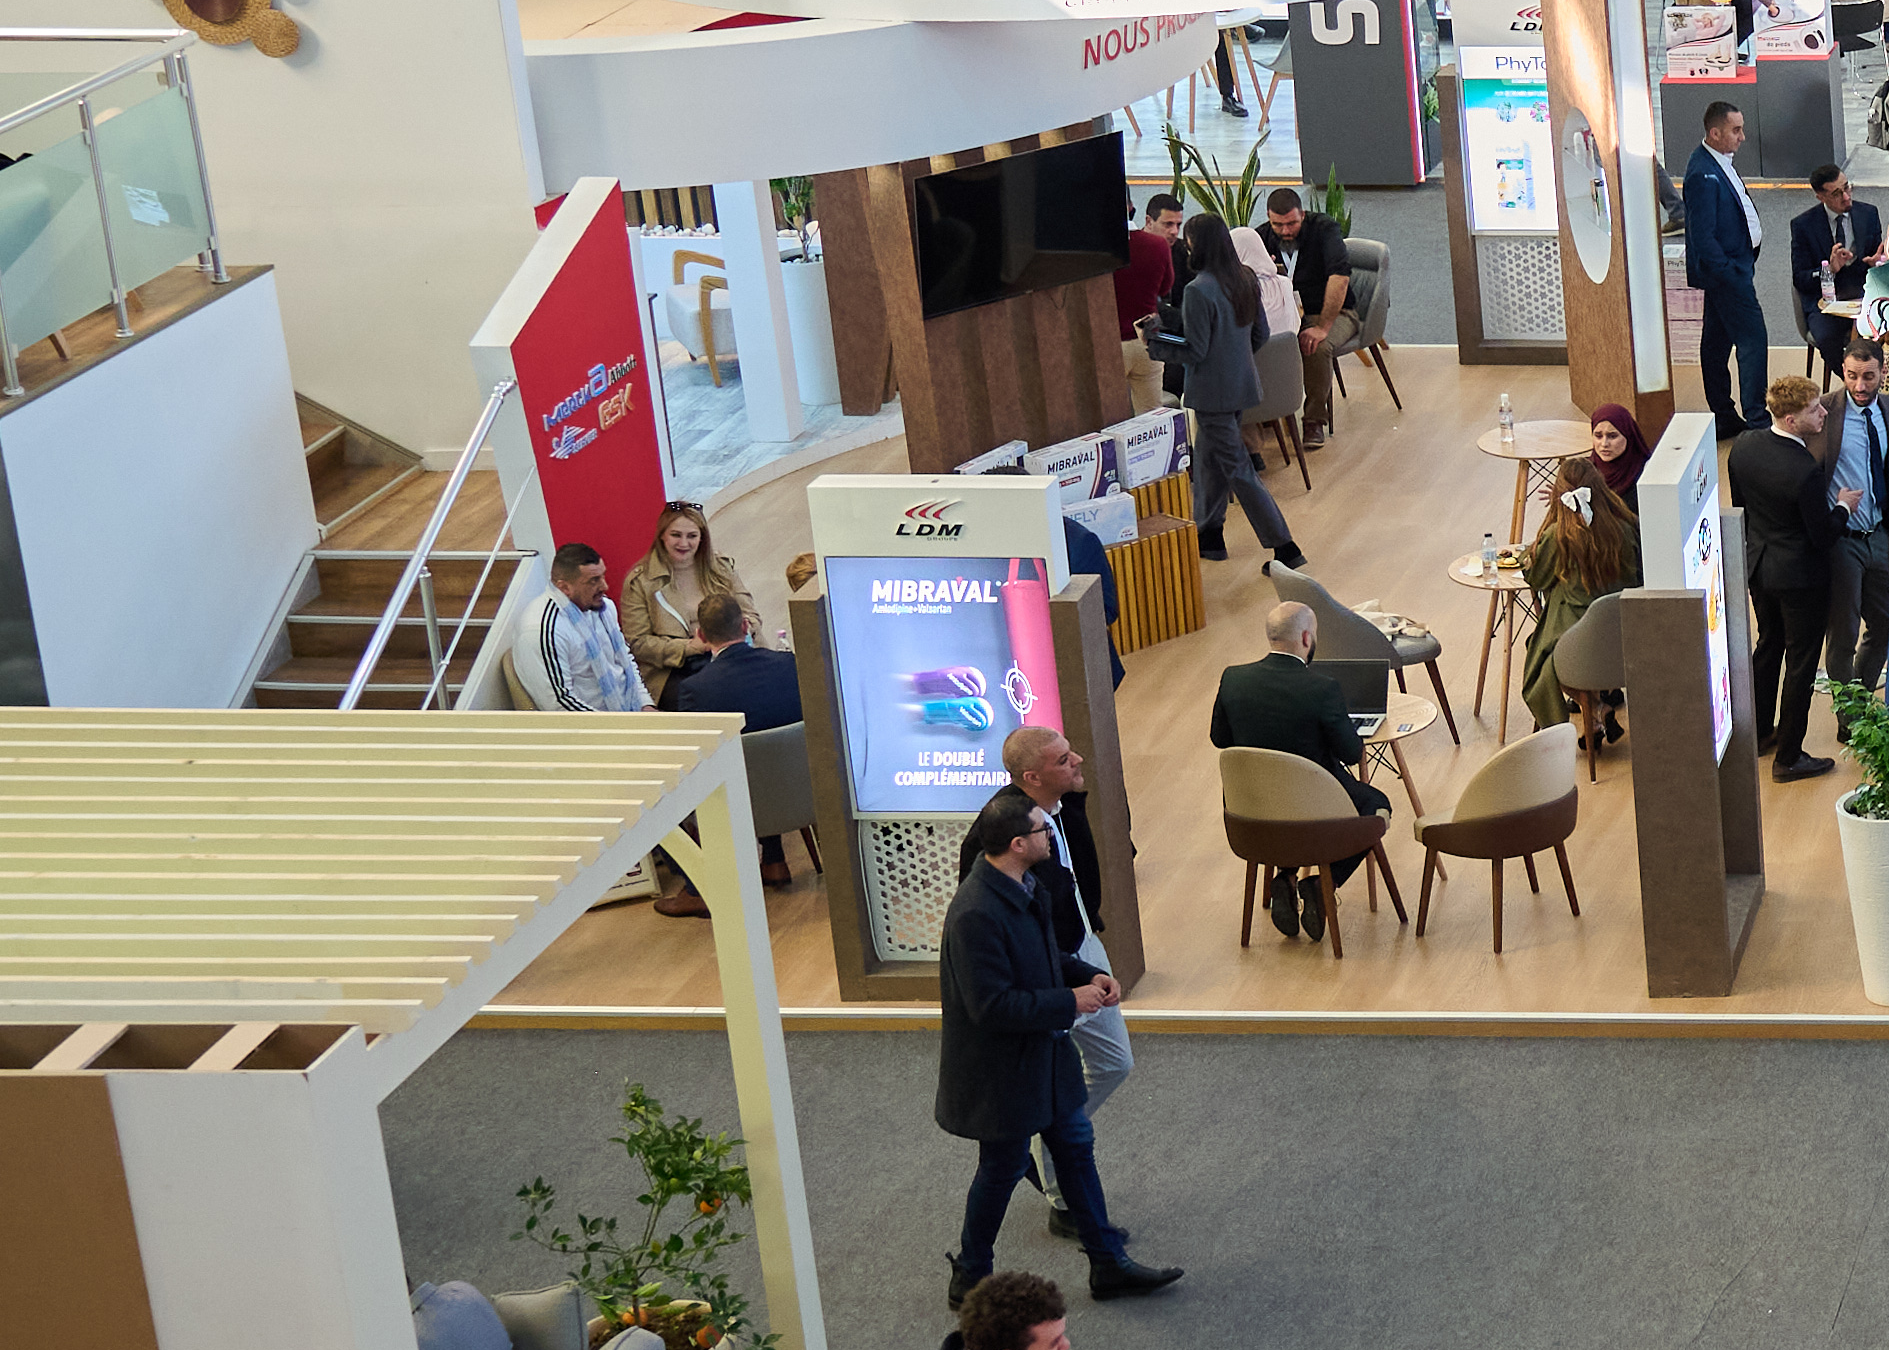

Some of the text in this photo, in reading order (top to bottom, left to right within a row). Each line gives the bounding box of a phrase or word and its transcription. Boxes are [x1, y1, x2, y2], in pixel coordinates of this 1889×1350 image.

[1509, 22, 1543, 32] LD
[1082, 17, 1151, 70] NOUS
[1126, 423, 1169, 449] MIBRAVAL
[1047, 450, 1096, 475] MIBRAVAL
[896, 523, 963, 536] LDM
[871, 578, 999, 603] MIBRAVAL
[918, 748, 985, 767] LE DOUBLÉ
